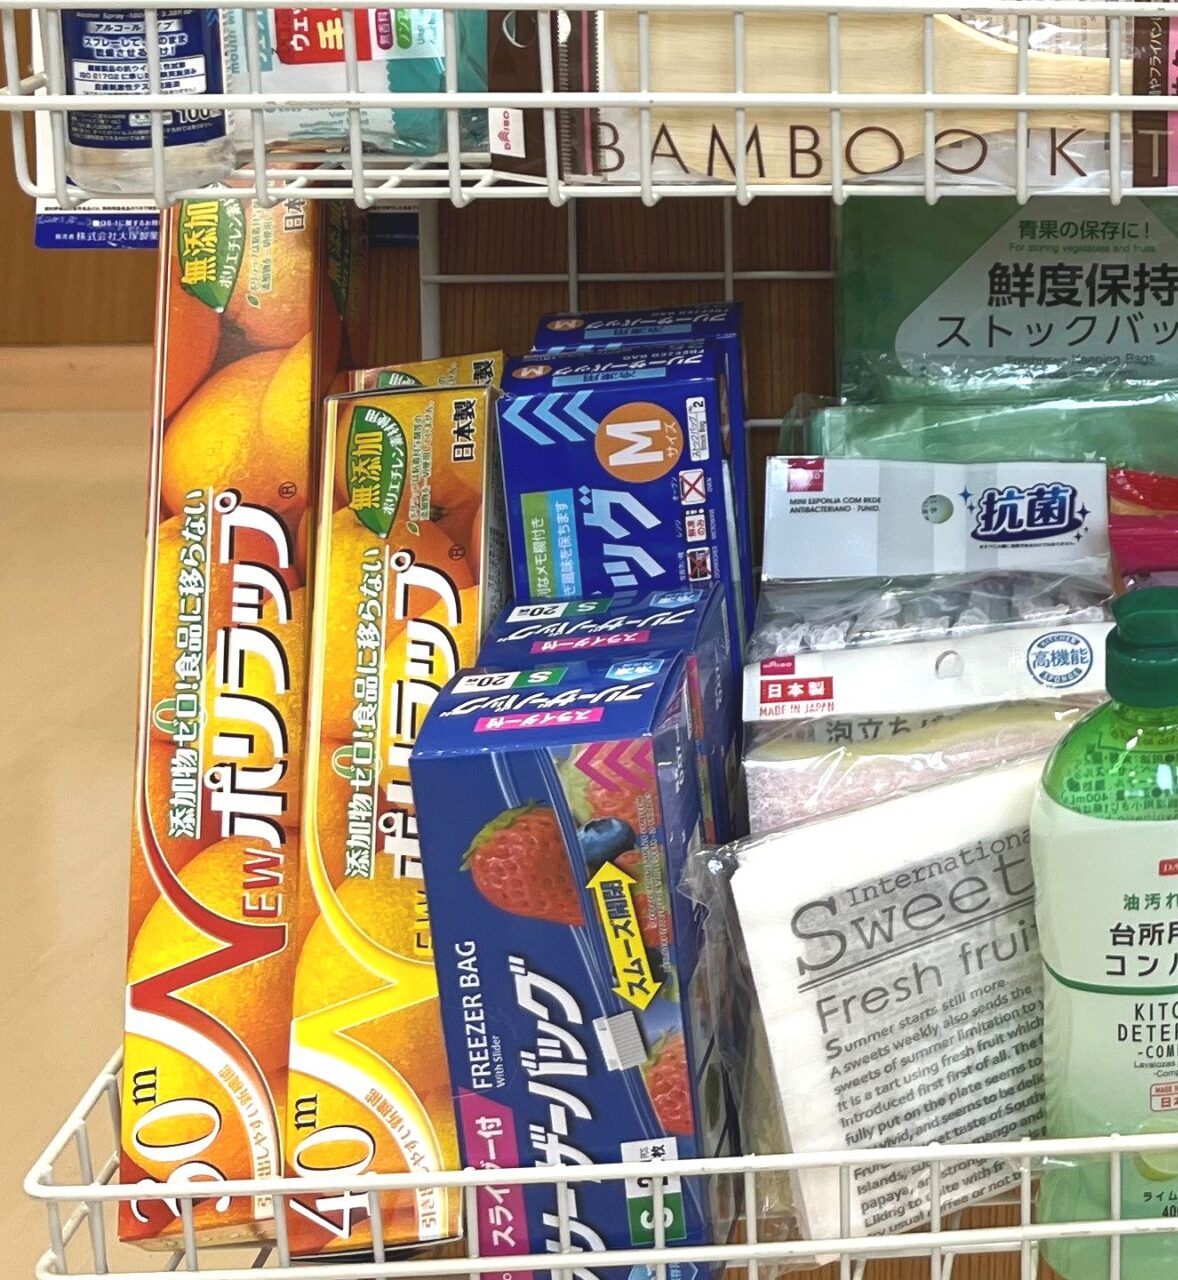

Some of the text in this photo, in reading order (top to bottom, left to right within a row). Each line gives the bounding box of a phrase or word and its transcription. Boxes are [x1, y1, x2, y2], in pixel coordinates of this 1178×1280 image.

[599, 121, 989, 180] BAMBOO
[181, 201, 219, 284] 無添加
[453, 399, 477, 462] 日本製
[667, 420, 679, 458] サイズ
[350, 432, 382, 509] 無添加
[980, 485, 1077, 533] 抗菌
[205, 488, 290, 847] ポリラップ
[1031, 647, 1089, 669] 高機能
[815, 917, 1039, 1035] Fresh frui
[455, 940, 493, 1089] FREEZER BAG
[825, 992, 966, 1060] Summer starts still
[843, 985, 1032, 1071] sweets weekly also sends the
[833, 1072, 881, 1095] sweets
[901, 1035, 954, 1066] summer
[874, 1032, 1005, 1097] tart using fresh fruit
